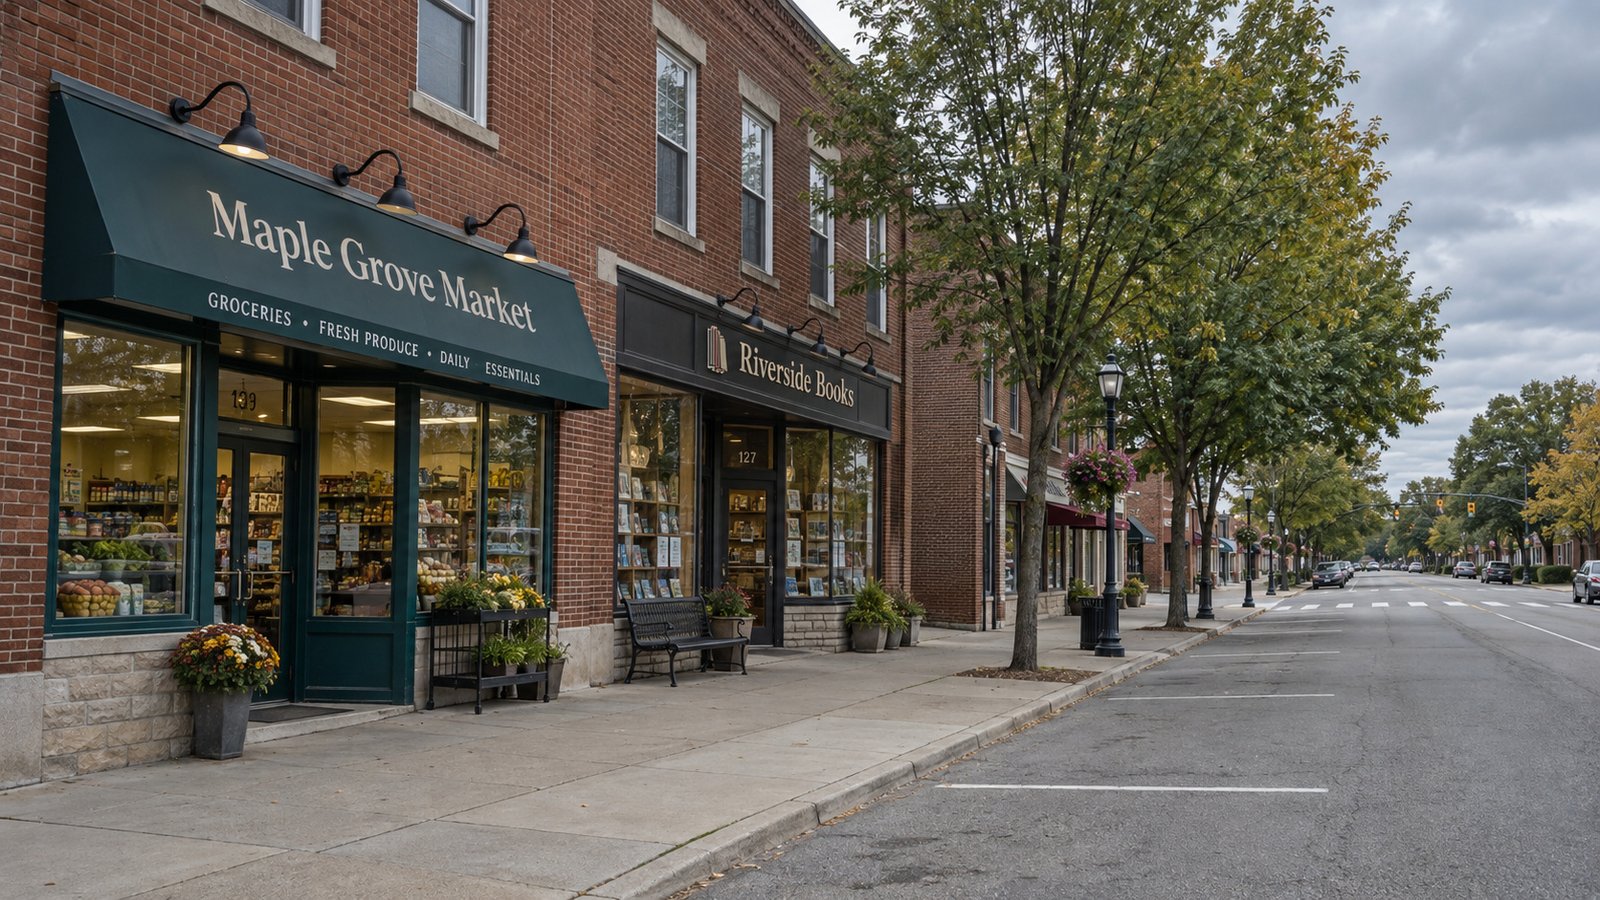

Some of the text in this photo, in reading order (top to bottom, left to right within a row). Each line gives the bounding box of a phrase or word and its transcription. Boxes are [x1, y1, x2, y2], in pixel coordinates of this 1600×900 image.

[207, 190, 537, 333] Maple Grove Market
[208, 292, 540, 386] GROCERIES FRESH PRODUCE DAILY ESSENTIALS
[739, 341, 855, 408] Riverside Books
[738, 451, 757, 464] 127
